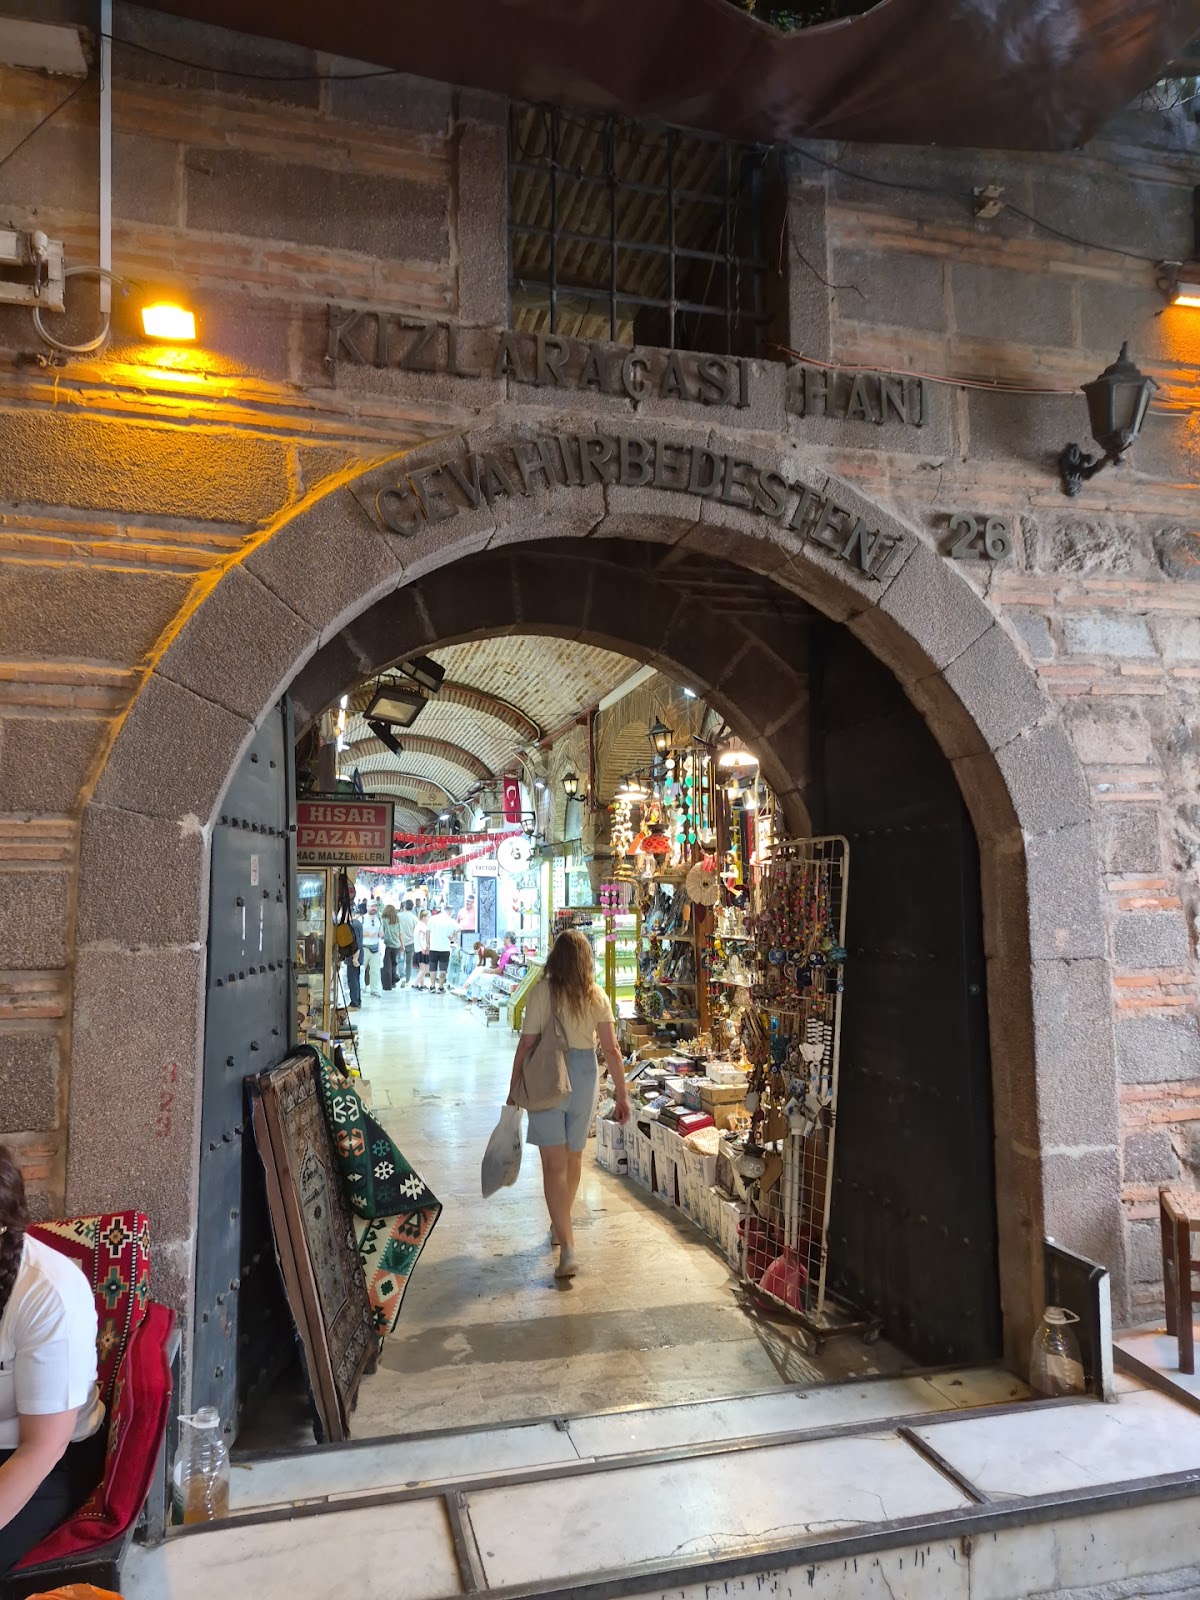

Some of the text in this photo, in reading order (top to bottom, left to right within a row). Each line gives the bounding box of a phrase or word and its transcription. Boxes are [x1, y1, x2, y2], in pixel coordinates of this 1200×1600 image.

[802, 367, 930, 427] HANI
[949, 512, 1012, 560] 26
[301, 829, 381, 846] PAZARI
